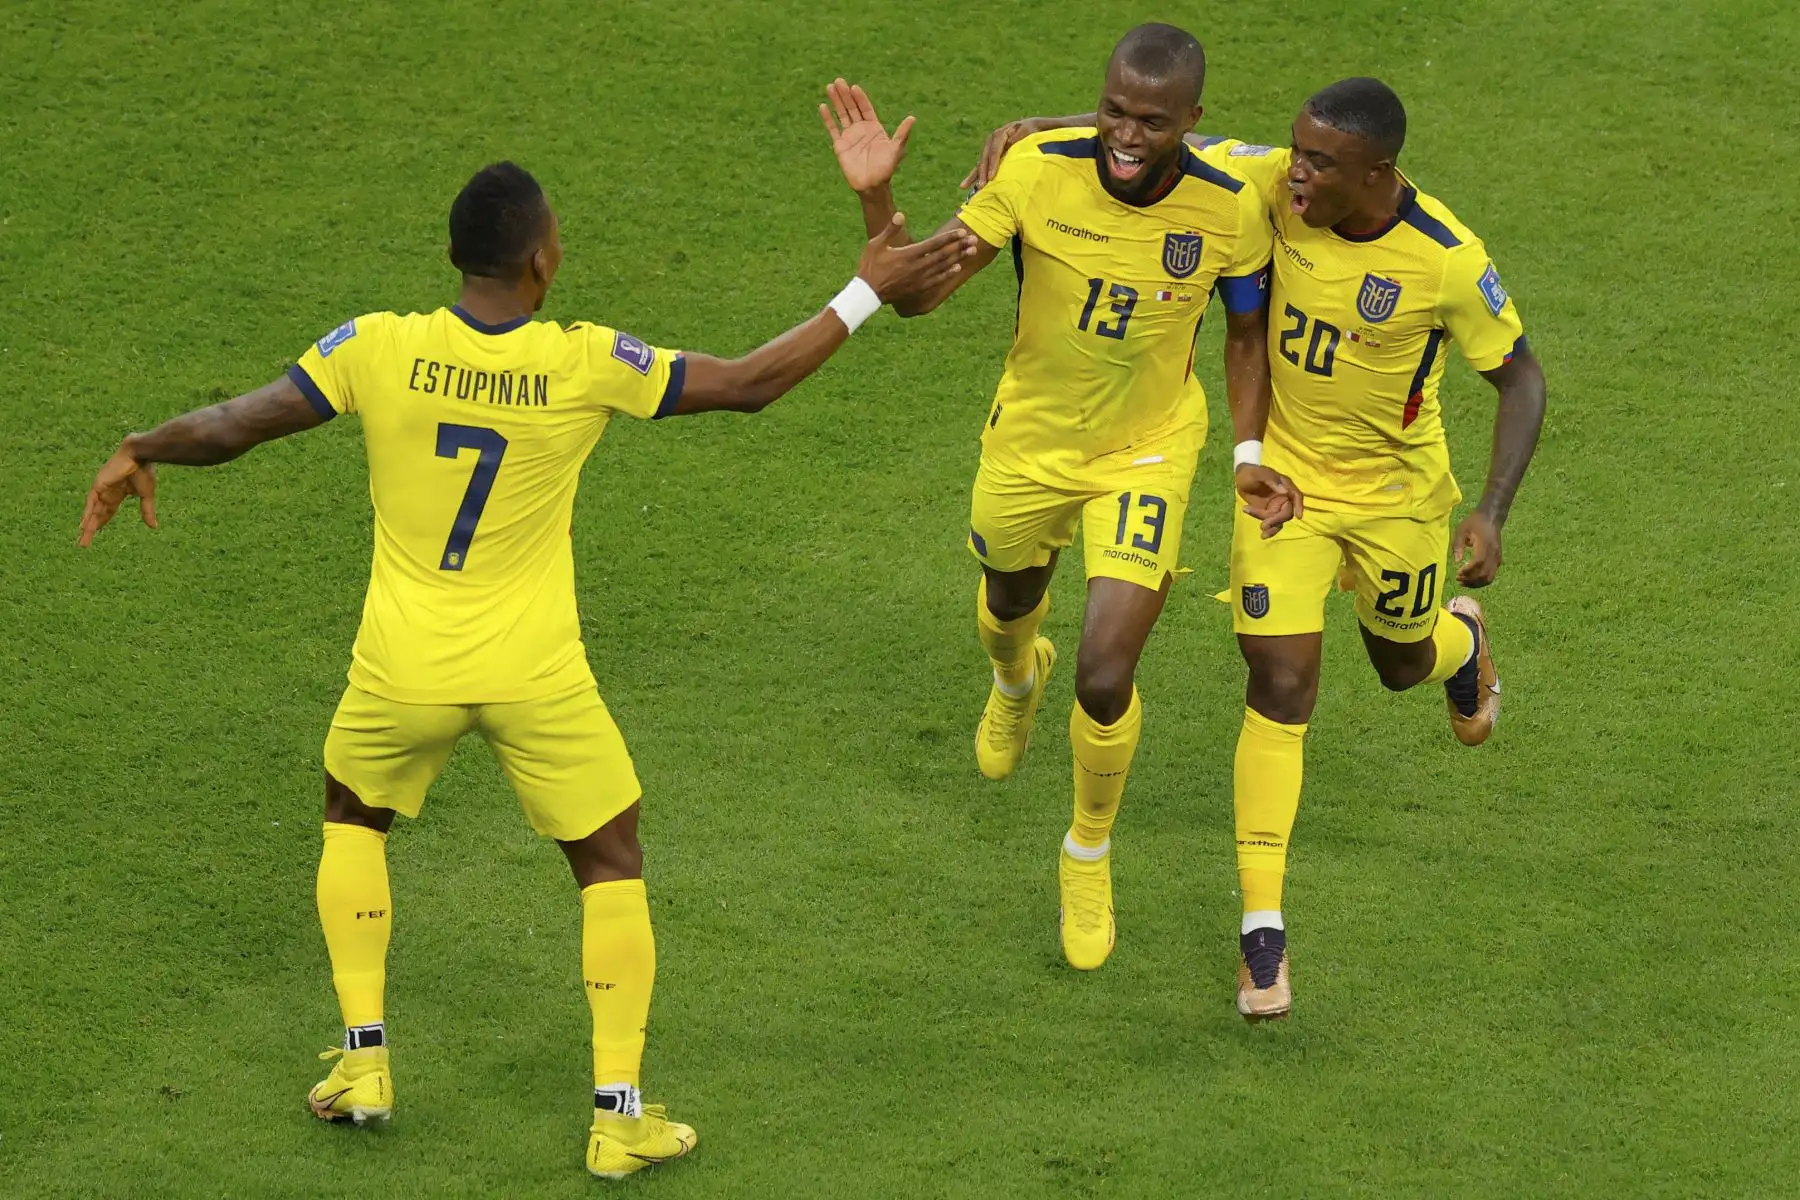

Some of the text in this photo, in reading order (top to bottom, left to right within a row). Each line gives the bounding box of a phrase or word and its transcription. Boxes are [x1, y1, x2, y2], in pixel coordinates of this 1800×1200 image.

[1046, 218, 1109, 244] marathon
[1077, 277, 1139, 341] 13
[1279, 302, 1341, 377] 20
[409, 358, 549, 407] ESTUPIÑAN
[434, 422, 509, 571] 7
[1115, 491, 1167, 555] 13
[1102, 548, 1158, 571] marathon
[1374, 563, 1437, 619] 20
[1375, 615, 1430, 630] marathon
[356, 910, 386, 919] FEF
[586, 980, 616, 990] FEF
